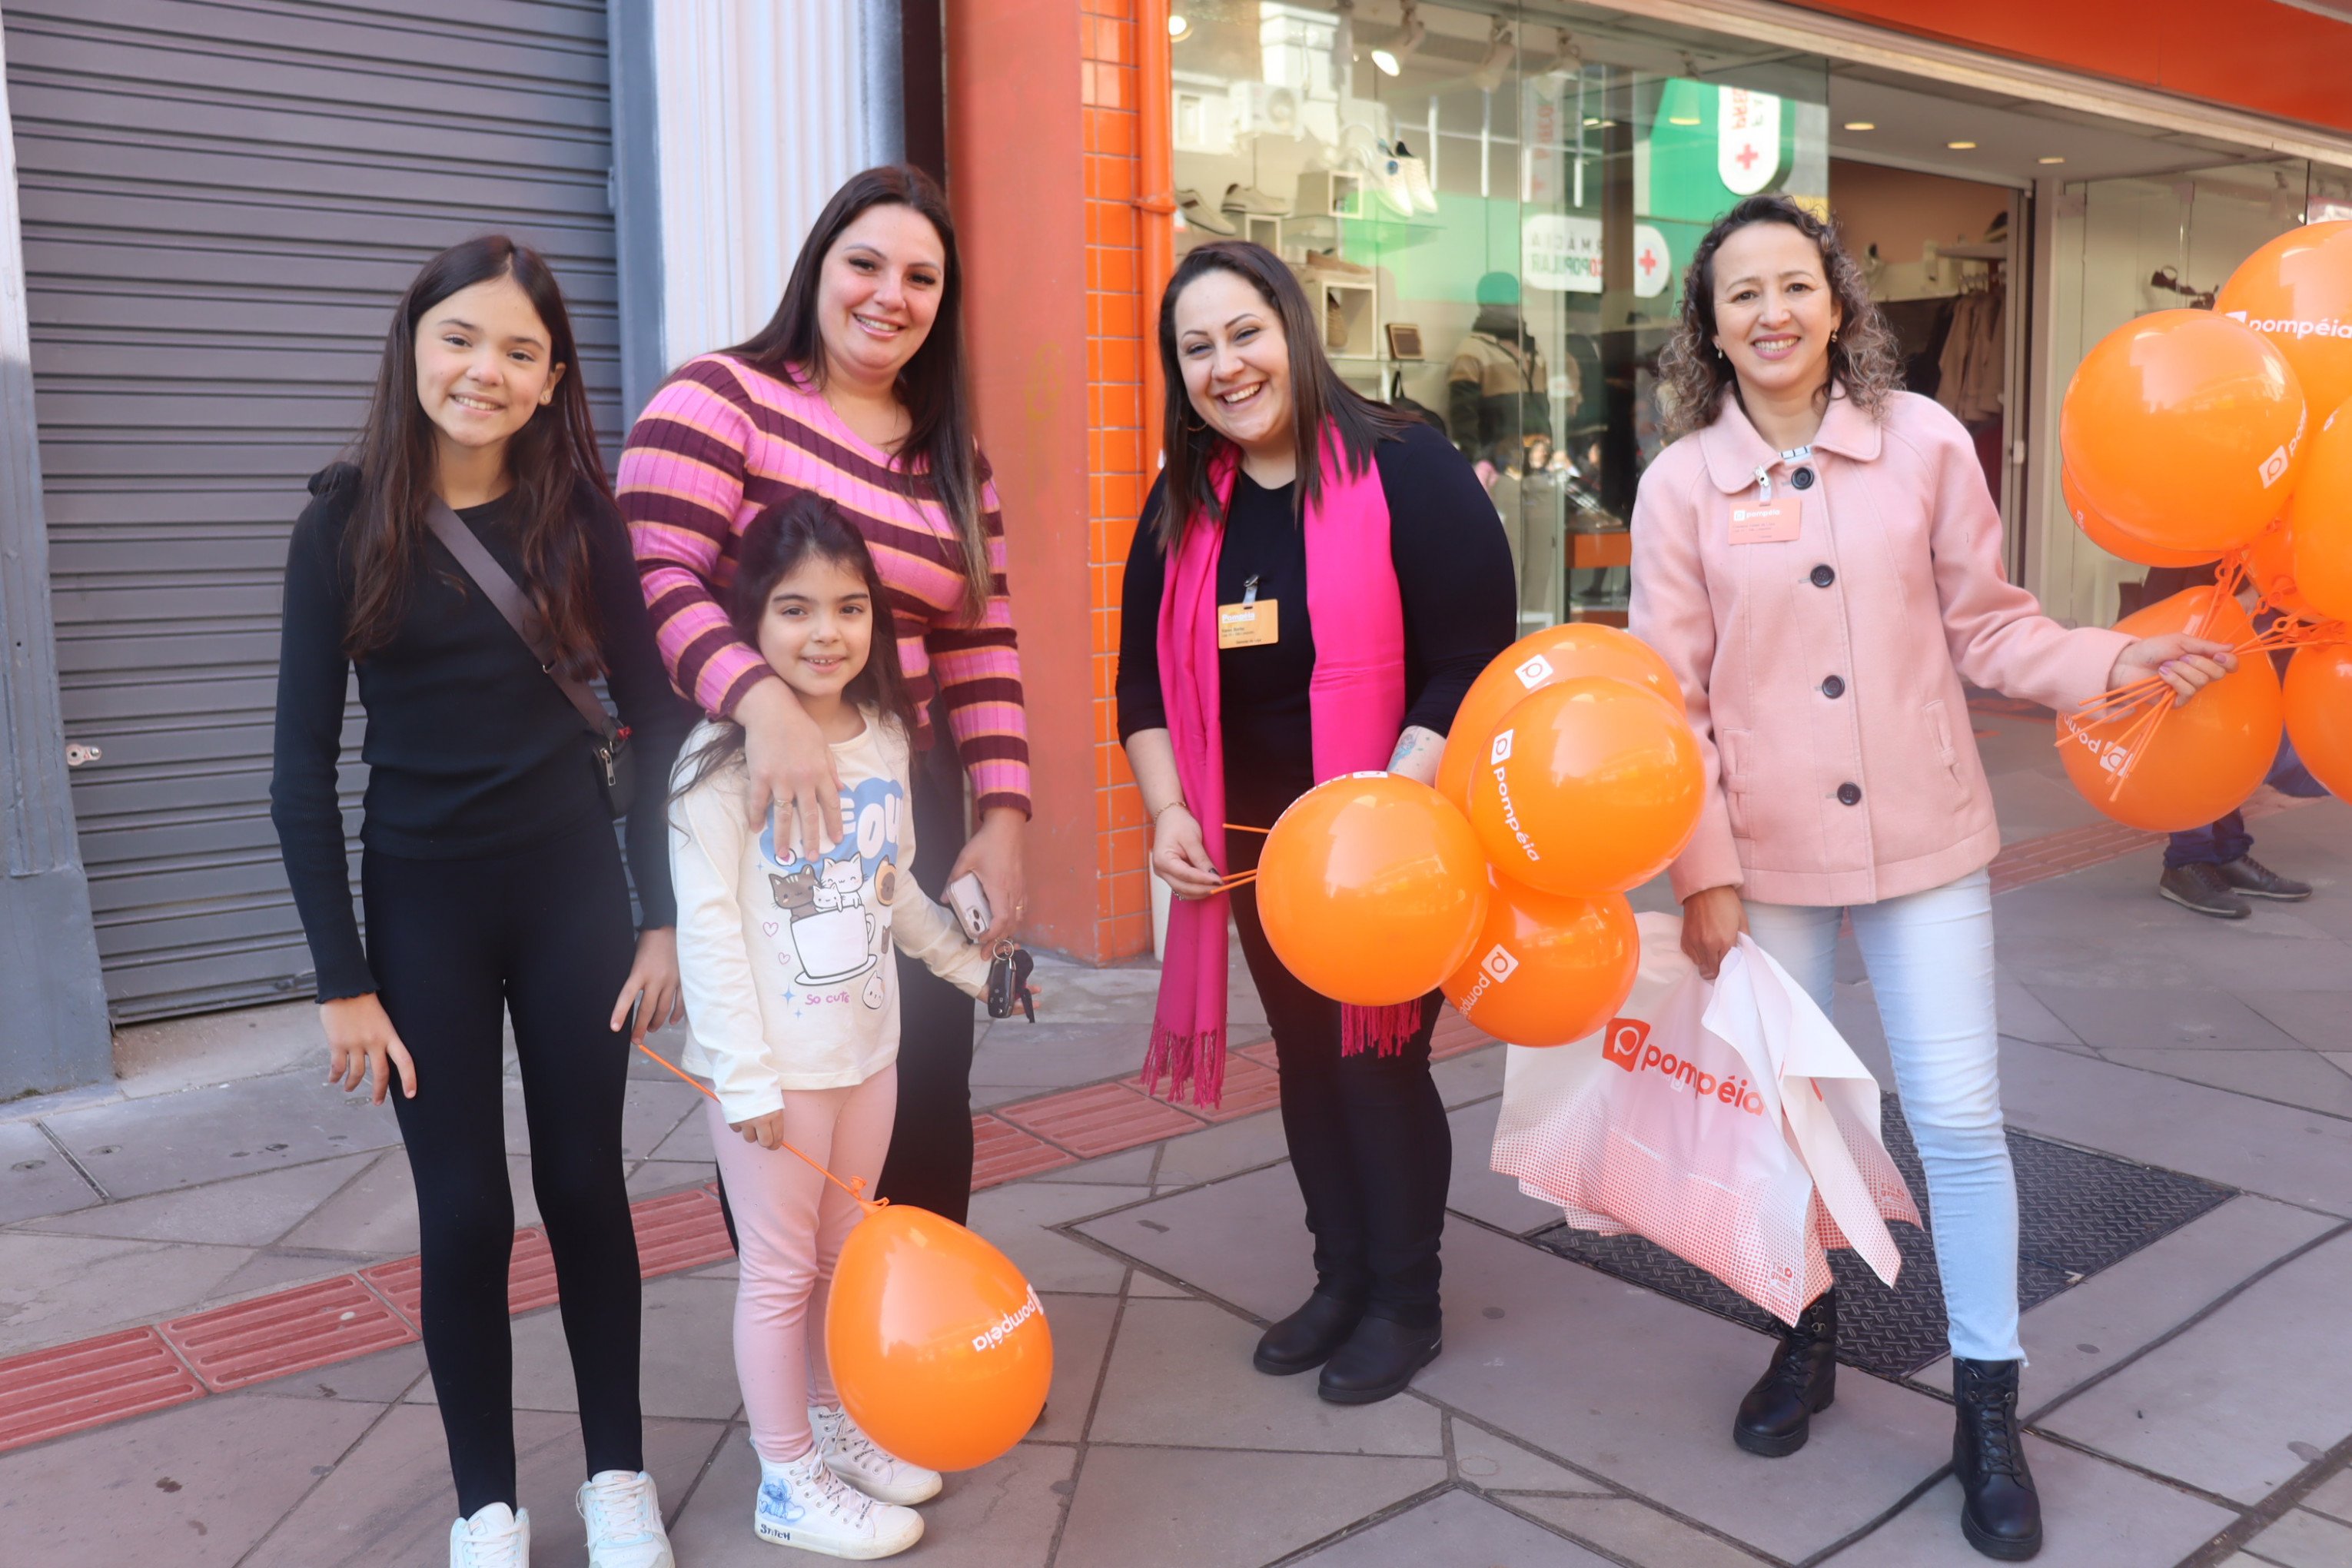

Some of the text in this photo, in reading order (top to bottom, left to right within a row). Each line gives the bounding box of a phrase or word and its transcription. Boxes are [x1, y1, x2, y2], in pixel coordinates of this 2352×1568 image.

[1493, 766, 1540, 862] pompéia
[1641, 1044, 1765, 1116] pompéia
[972, 1294, 1036, 1352] pompéia
